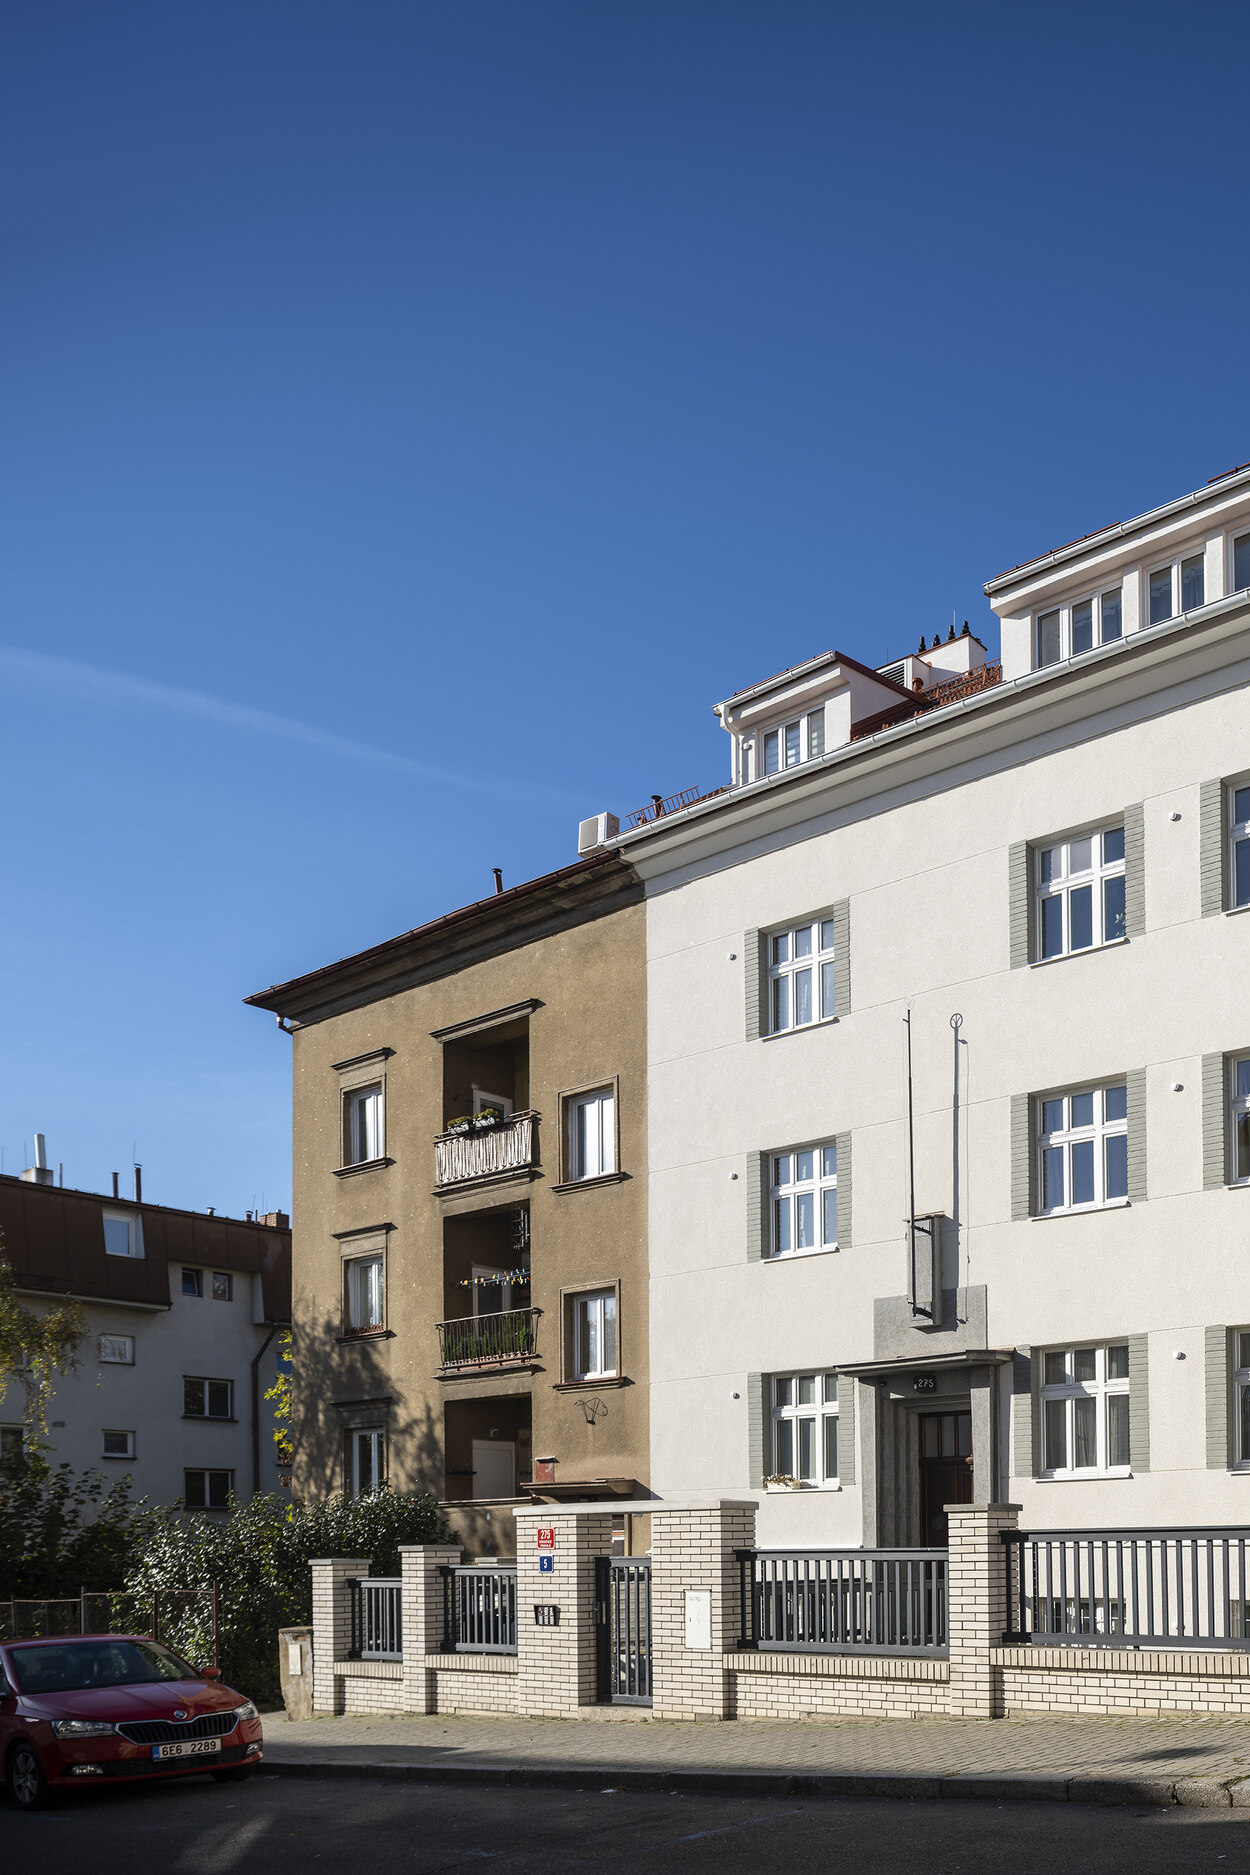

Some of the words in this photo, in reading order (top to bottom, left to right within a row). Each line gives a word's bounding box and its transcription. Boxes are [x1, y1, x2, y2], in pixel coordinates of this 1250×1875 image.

[918, 1378, 934, 1388] 275
[540, 1529, 551, 1540] 275
[543, 1558, 548, 1569] 5
[162, 1745, 182, 1756] 6E6
[190, 1740, 217, 1753] 2289
